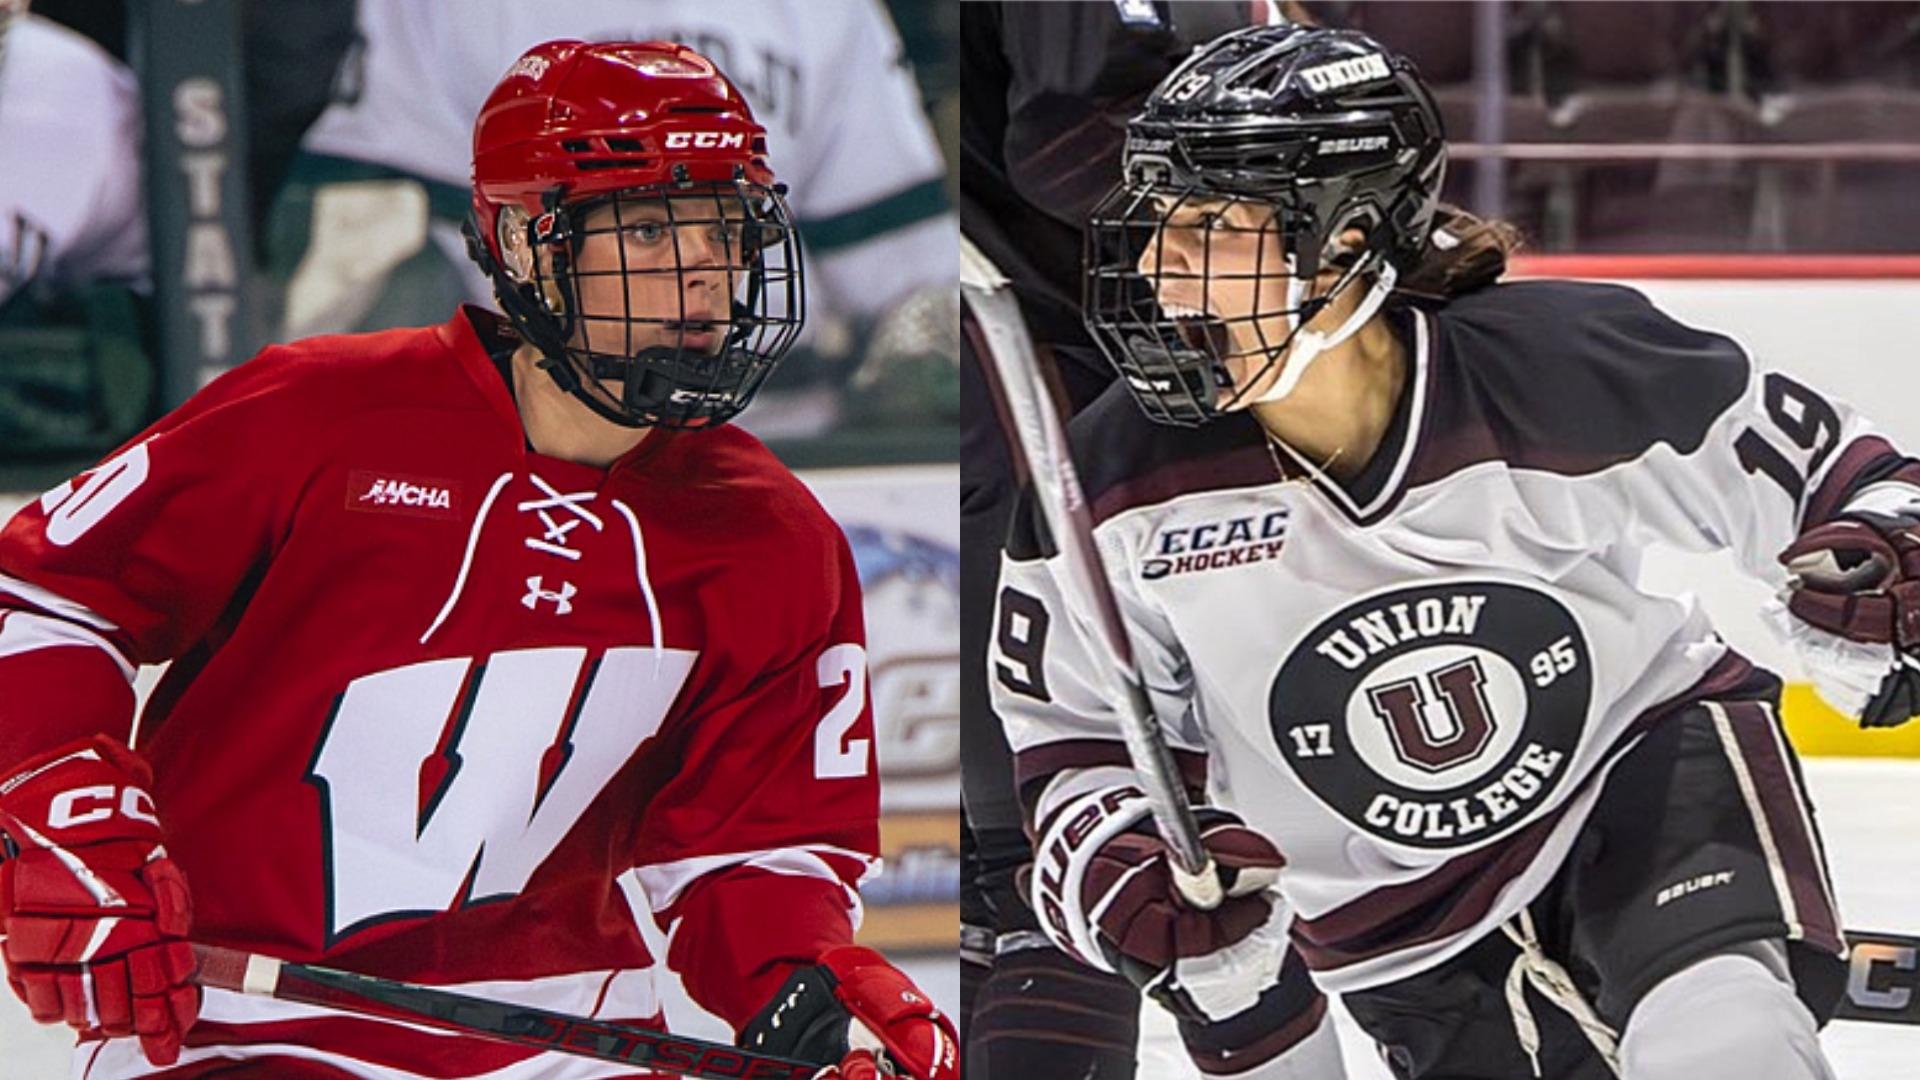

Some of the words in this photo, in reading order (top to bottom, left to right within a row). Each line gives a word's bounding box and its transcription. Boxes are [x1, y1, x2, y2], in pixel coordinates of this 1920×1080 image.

[1299, 53, 1390, 92] UNION
[664, 131, 744, 149] CCM
[1733, 372, 1841, 533] 19
[1157, 510, 1290, 556] ECAC
[1174, 541, 1284, 575] HOCKEY
[1316, 595, 1486, 669] UNION
[1529, 635, 1578, 688] 95
[1289, 723, 1335, 757] 17
[1365, 655, 1498, 775] U
[304, 646, 699, 951] W
[1363, 742, 1563, 839] COLLEGE
